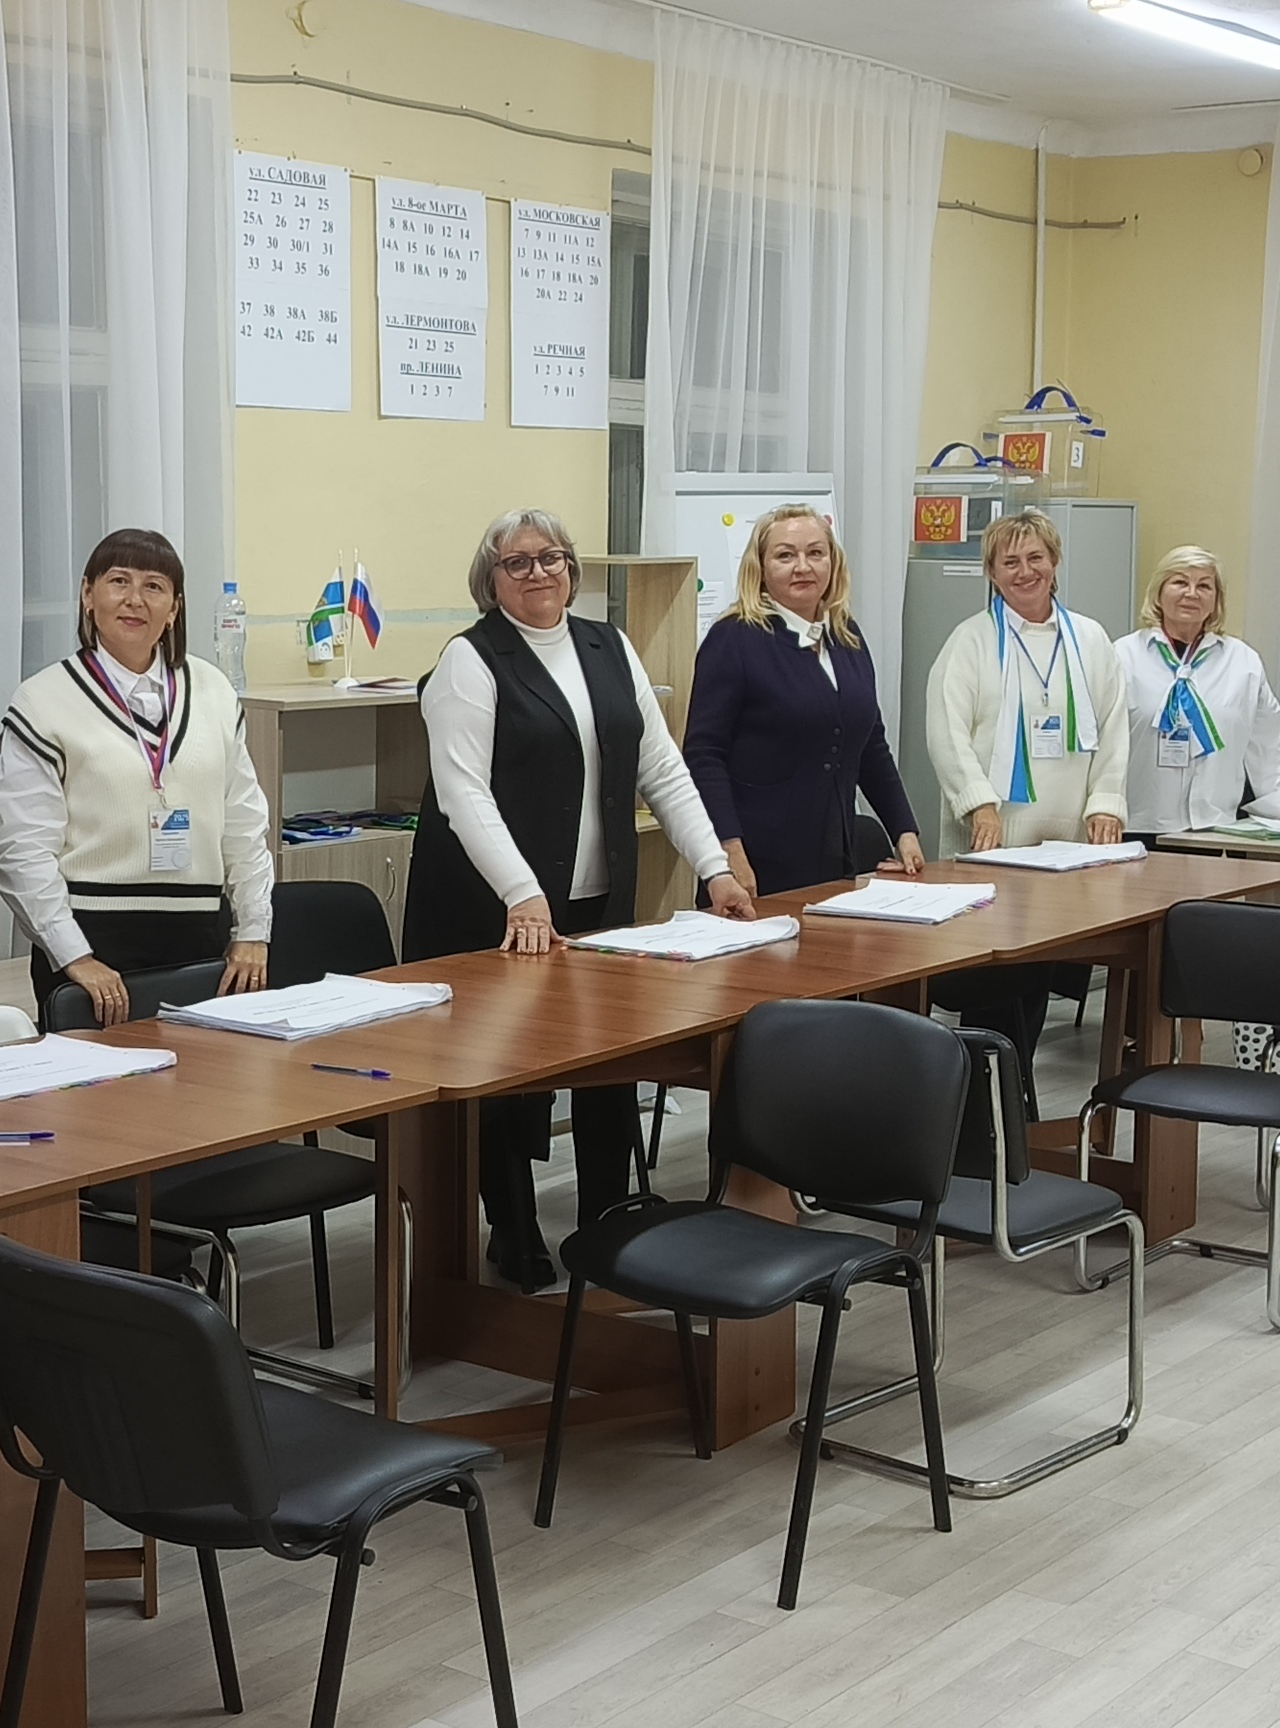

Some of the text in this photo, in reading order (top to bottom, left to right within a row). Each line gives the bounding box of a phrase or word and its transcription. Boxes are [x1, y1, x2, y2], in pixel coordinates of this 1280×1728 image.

[248, 166, 326, 186] ул. САДОВАЯ
[247, 188, 330, 211] 22 23 24 25
[392, 196, 467, 218] ул. 8-ое МАРТА
[243, 210, 334, 234] 25А 26 27 28
[518, 208, 601, 228] ул. МОСКОВСКАЯ
[389, 216, 470, 241] 8 8А 10 12 14
[524, 228, 530, 239] 7
[535, 230, 542, 240] 9
[548, 231, 556, 243] 11
[586, 236, 595, 248] 12
[243, 233, 333, 256] 29 30 30/1 31
[407, 241, 418, 254] 15
[425, 244, 436, 257] 16
[469, 250, 480, 262] 17
[517, 246, 526, 259] 13
[555, 251, 565, 263] 14
[571, 253, 580, 265] 15
[248, 256, 330, 277] 33 34 35 36
[394, 260, 406, 274] 18
[438, 266, 448, 279] 19
[456, 268, 467, 281] 20
[520, 266, 530, 278] 16
[536, 268, 546, 280] 17
[552, 270, 561, 282] 18
[589, 274, 599, 286] 20
[558, 289, 568, 302] 22
[574, 291, 583, 303] 24
[239, 301, 338, 324] 37 38 38А 38Б
[386, 314, 477, 333] ул. ЛЕРМОНТОВА
[240, 324, 338, 345] 42 42А 42Б 44
[408, 337, 455, 353] 21 23 25
[533, 344, 585, 358] ул. РЕЧНАЯ
[400, 360, 462, 376] пр. ЛЕНИНА
[535, 363, 585, 378] 1 2 3 4 5
[410, 383, 453, 397] 1 2 3 7
[543, 384, 575, 397] 7 9 11
[1072, 446, 1080, 464] 3
